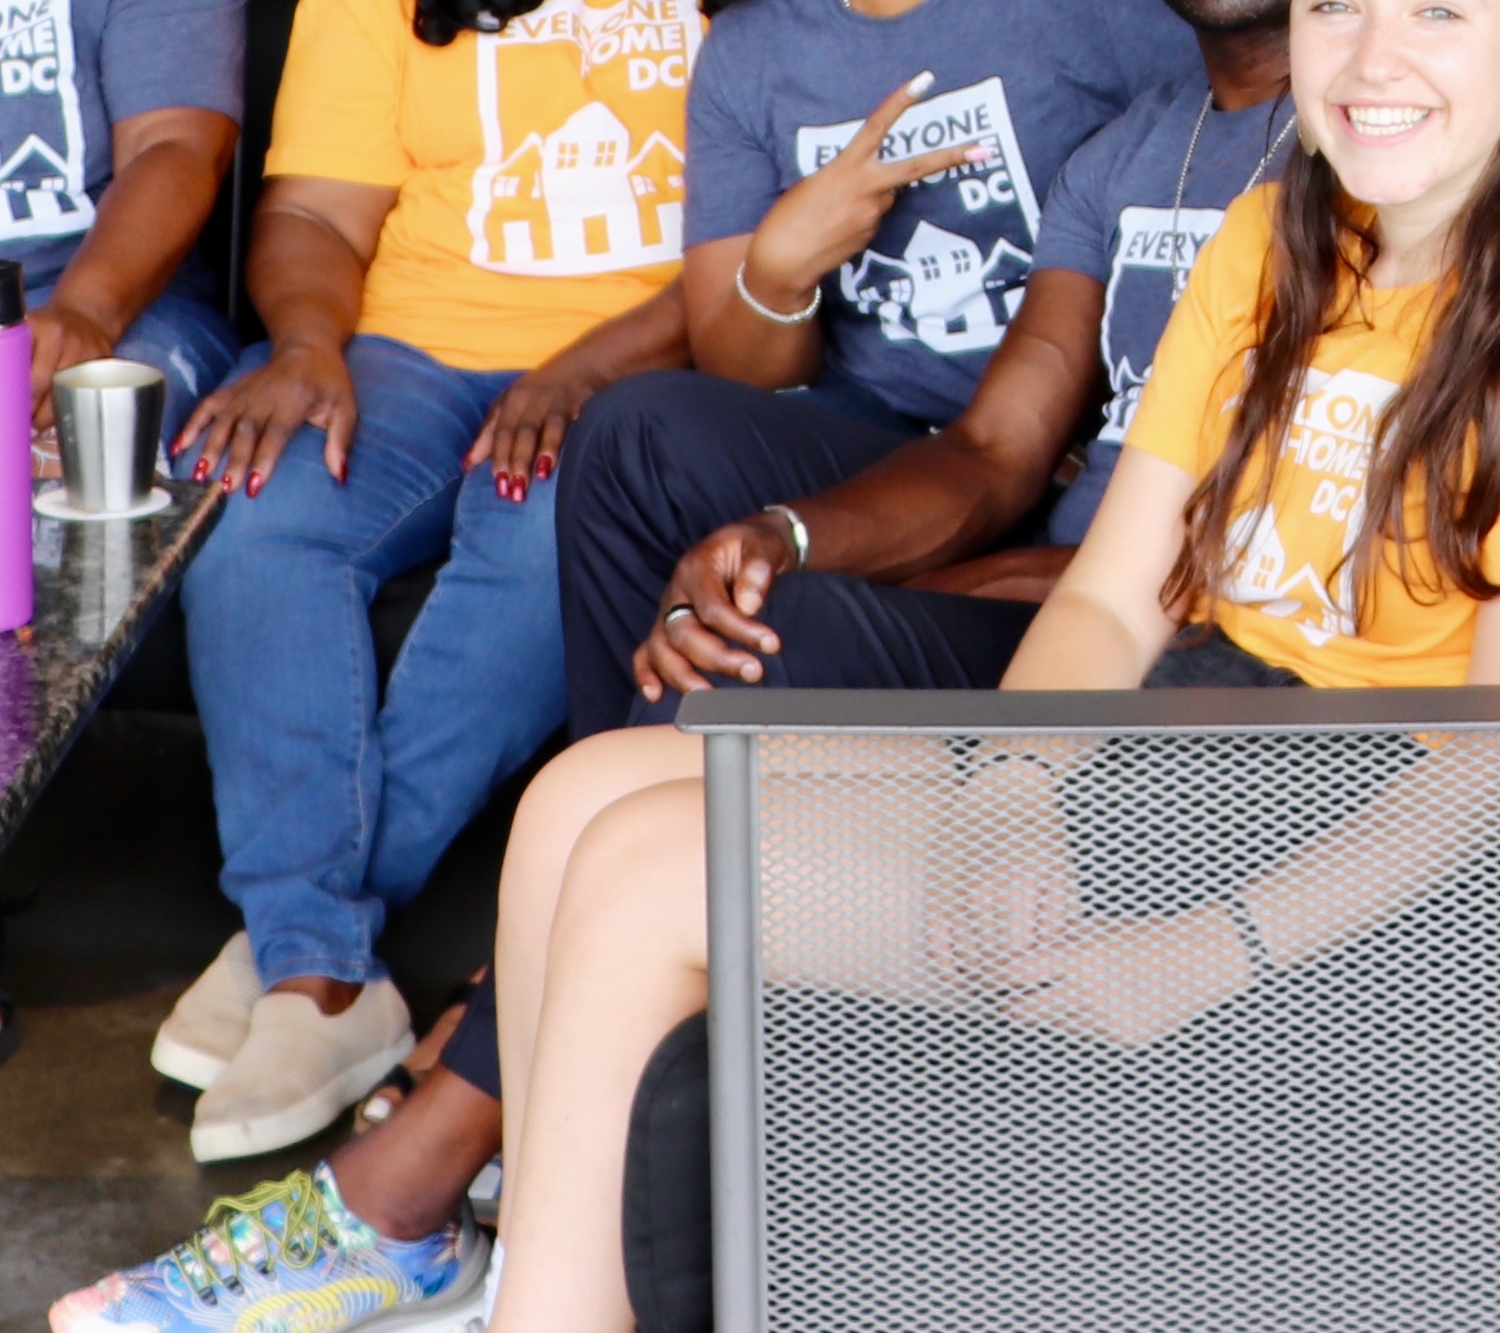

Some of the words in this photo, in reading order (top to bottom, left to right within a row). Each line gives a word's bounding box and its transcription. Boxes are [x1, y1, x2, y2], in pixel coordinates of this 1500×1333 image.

[1, 55, 57, 94] DC
[628, 54, 686, 91] DC
[814, 103, 992, 168] ERYONE
[958, 169, 1015, 212] DC
[1309, 479, 1357, 522] DC
